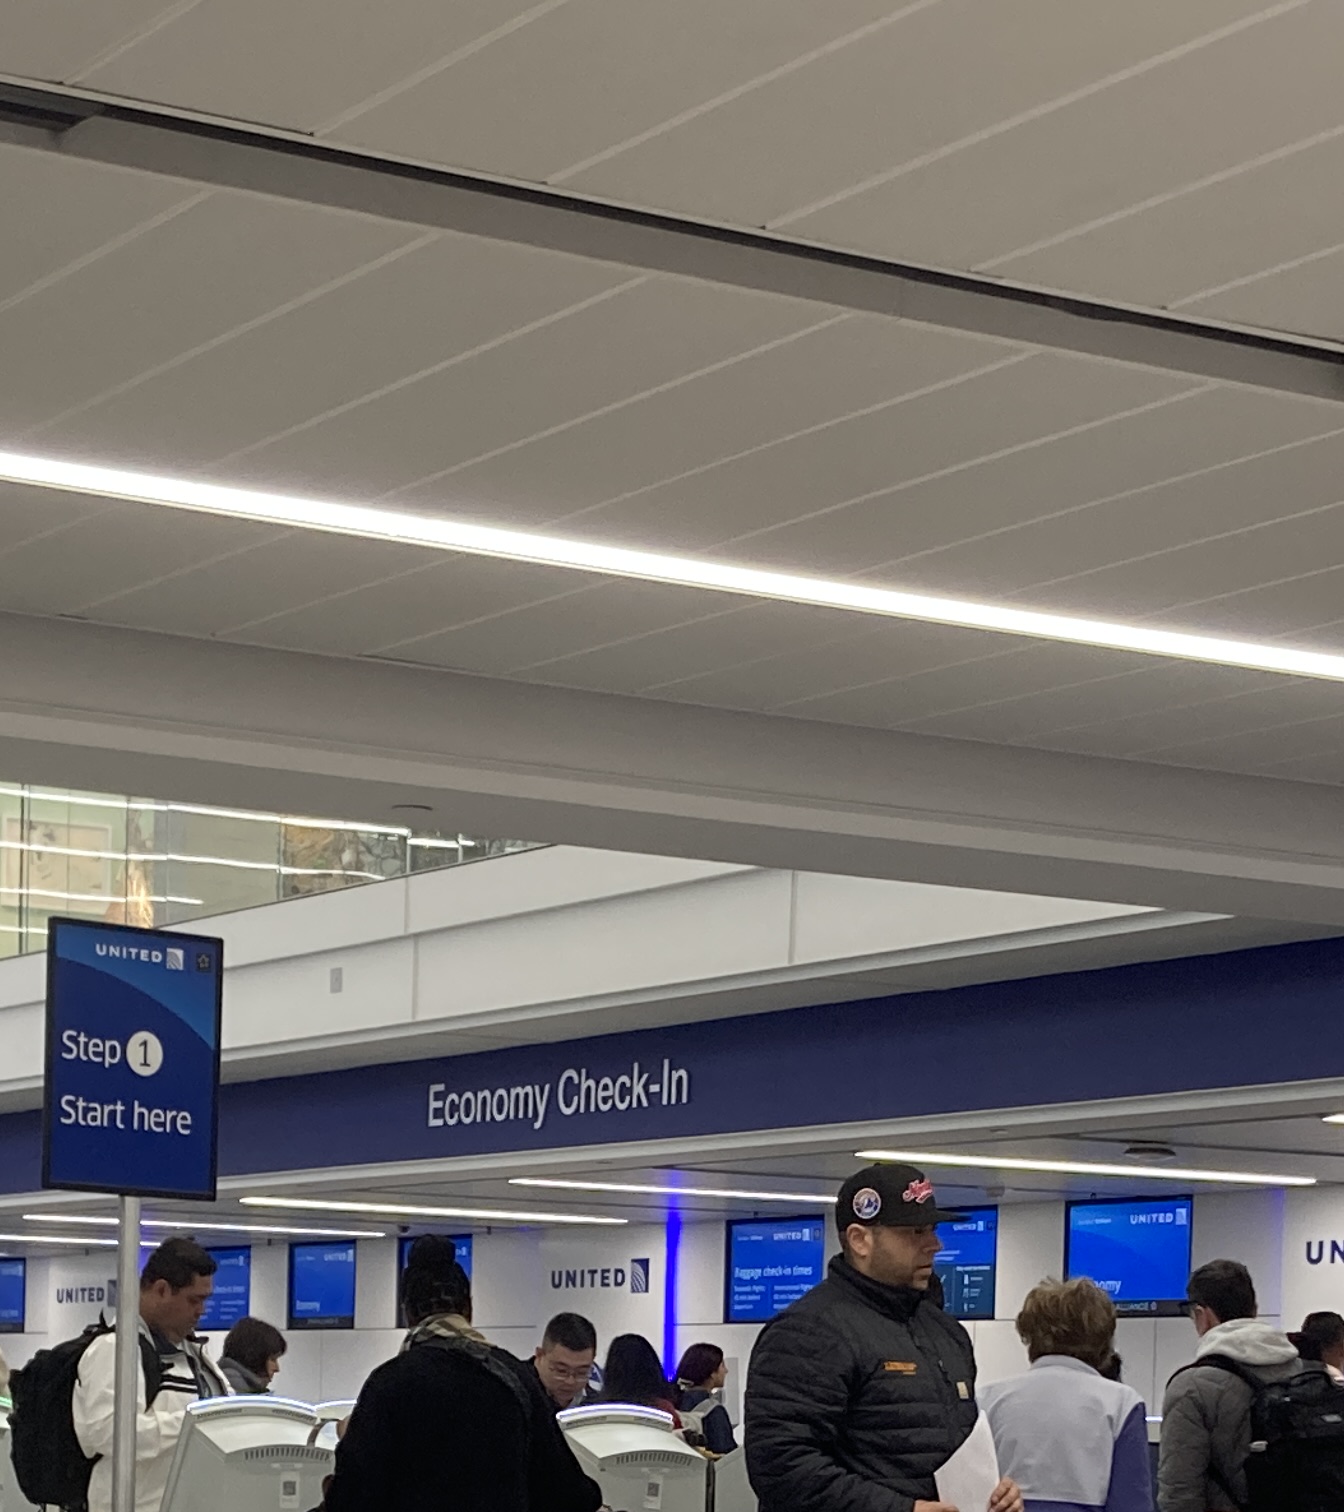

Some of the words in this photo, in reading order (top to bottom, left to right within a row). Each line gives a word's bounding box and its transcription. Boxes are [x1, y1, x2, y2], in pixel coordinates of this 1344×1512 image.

[95, 943, 162, 963] UNITED
[61, 1029, 122, 1069] Step
[428, 1083, 550, 1130] Economy
[558, 1058, 689, 1116] Check-In
[60, 1094, 126, 1130] Start
[133, 1100, 192, 1135] here
[1129, 1212, 1174, 1225] UNITED
[551, 1267, 626, 1290] UNITED
[56, 1287, 105, 1304] UNITED
